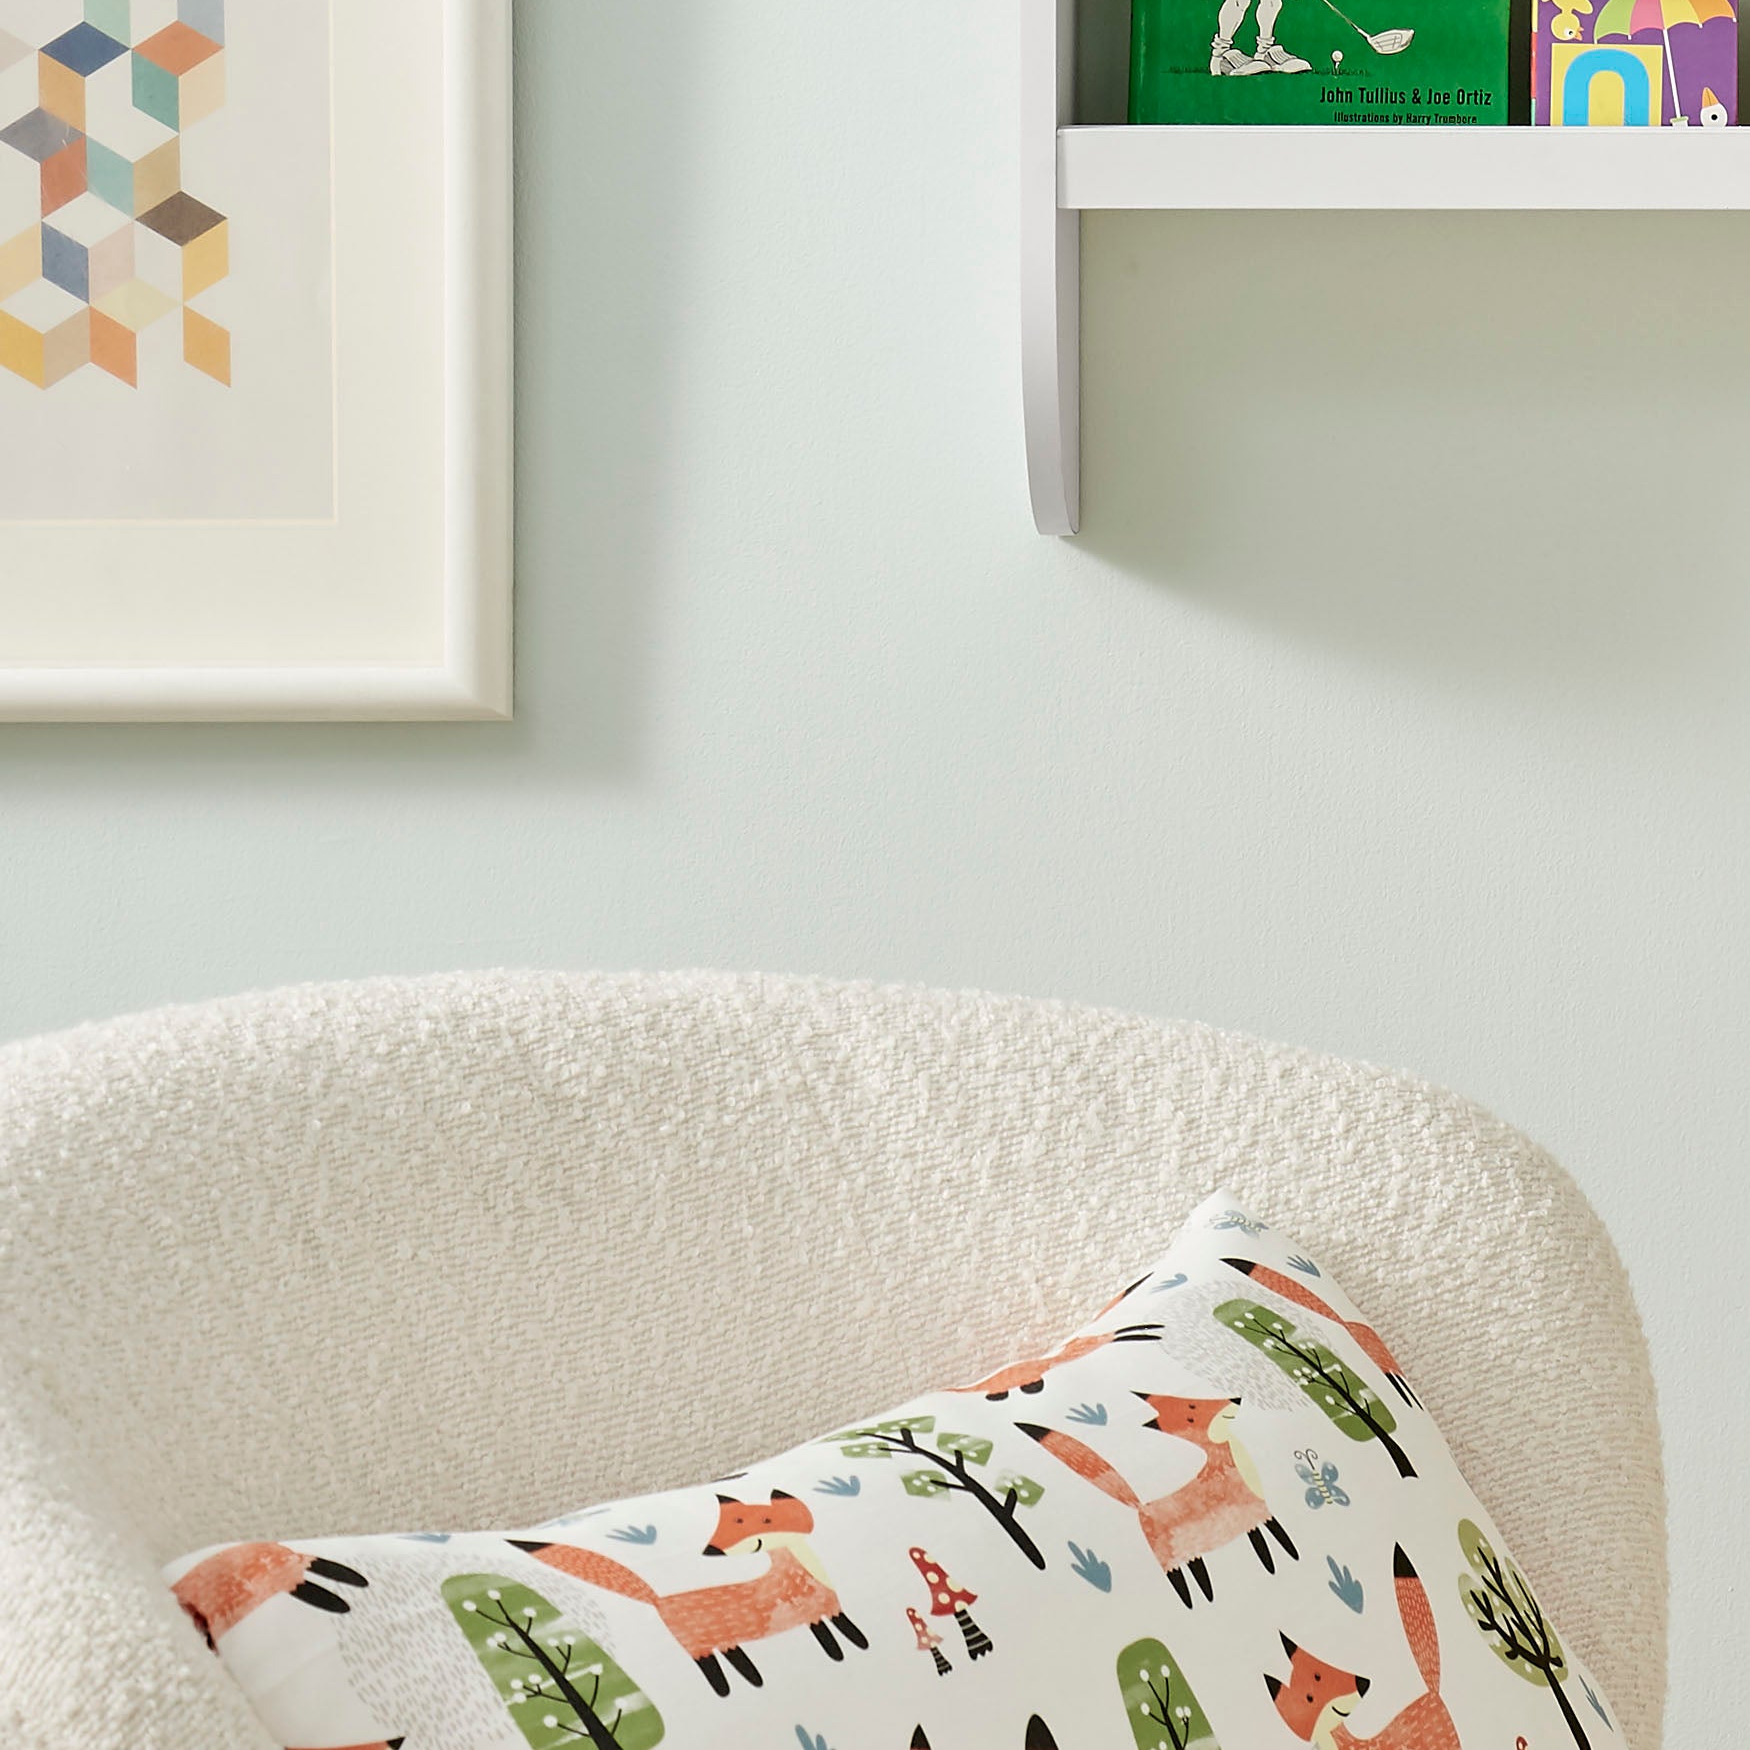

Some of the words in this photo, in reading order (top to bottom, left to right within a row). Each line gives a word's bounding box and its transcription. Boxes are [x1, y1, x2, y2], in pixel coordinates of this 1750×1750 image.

[1319, 86, 1353, 104] John
[1358, 87, 1407, 105] Tullius
[1412, 88, 1422, 105] &
[1426, 88, 1451, 105] Joe
[1456, 88, 1492, 106] Ortiz
[1333, 111, 1390, 124] Illustrations
[1392, 112, 1404, 125] by
[1406, 113, 1432, 126] Harry
